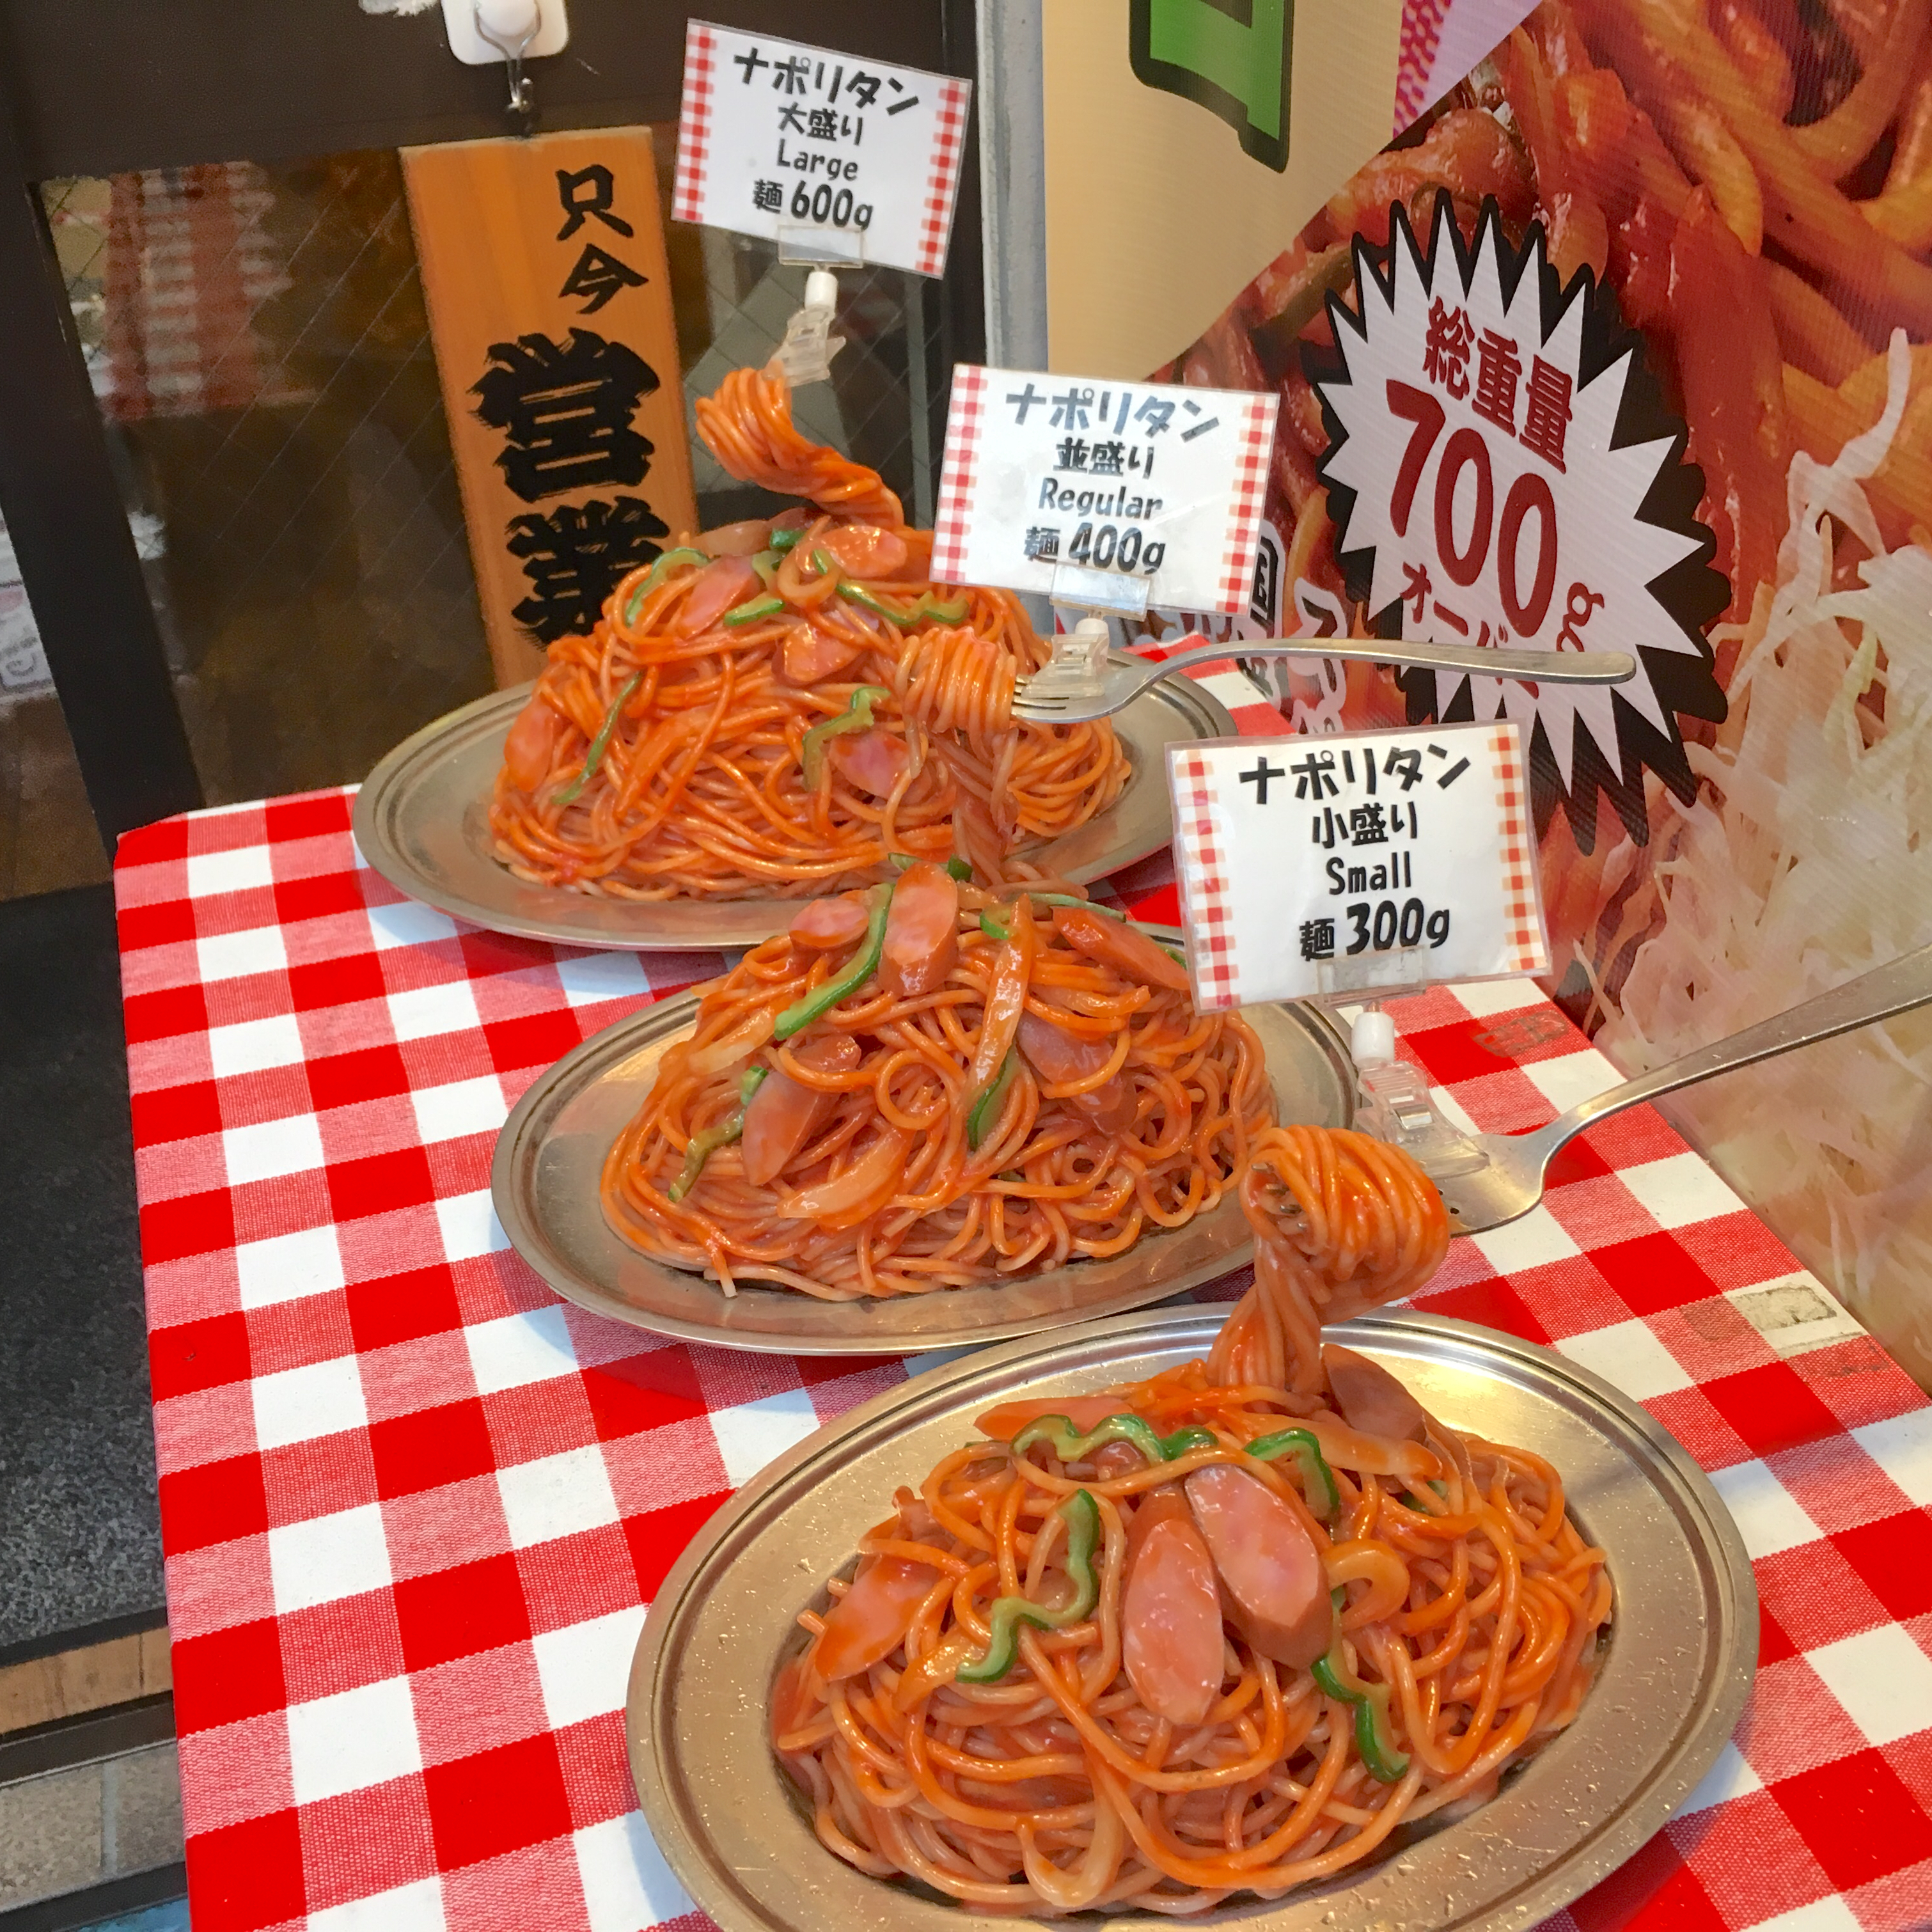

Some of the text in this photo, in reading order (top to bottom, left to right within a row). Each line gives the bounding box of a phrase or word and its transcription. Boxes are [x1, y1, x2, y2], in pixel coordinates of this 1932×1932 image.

[734, 47, 919, 115] ナポリタン
[778, 102, 863, 146] 大盛り
[776, 138, 858, 181] Large
[1422, 295, 1574, 475] 総重量
[1006, 383, 1220, 443] ナポリタン
[1053, 436, 1154, 479] 並盛り
[1038, 477, 1163, 520] Regular
[1239, 743, 1471, 805] ナポリタン
[1312, 801, 1418, 849] 小盛り
[1325, 851, 1411, 895] Small
